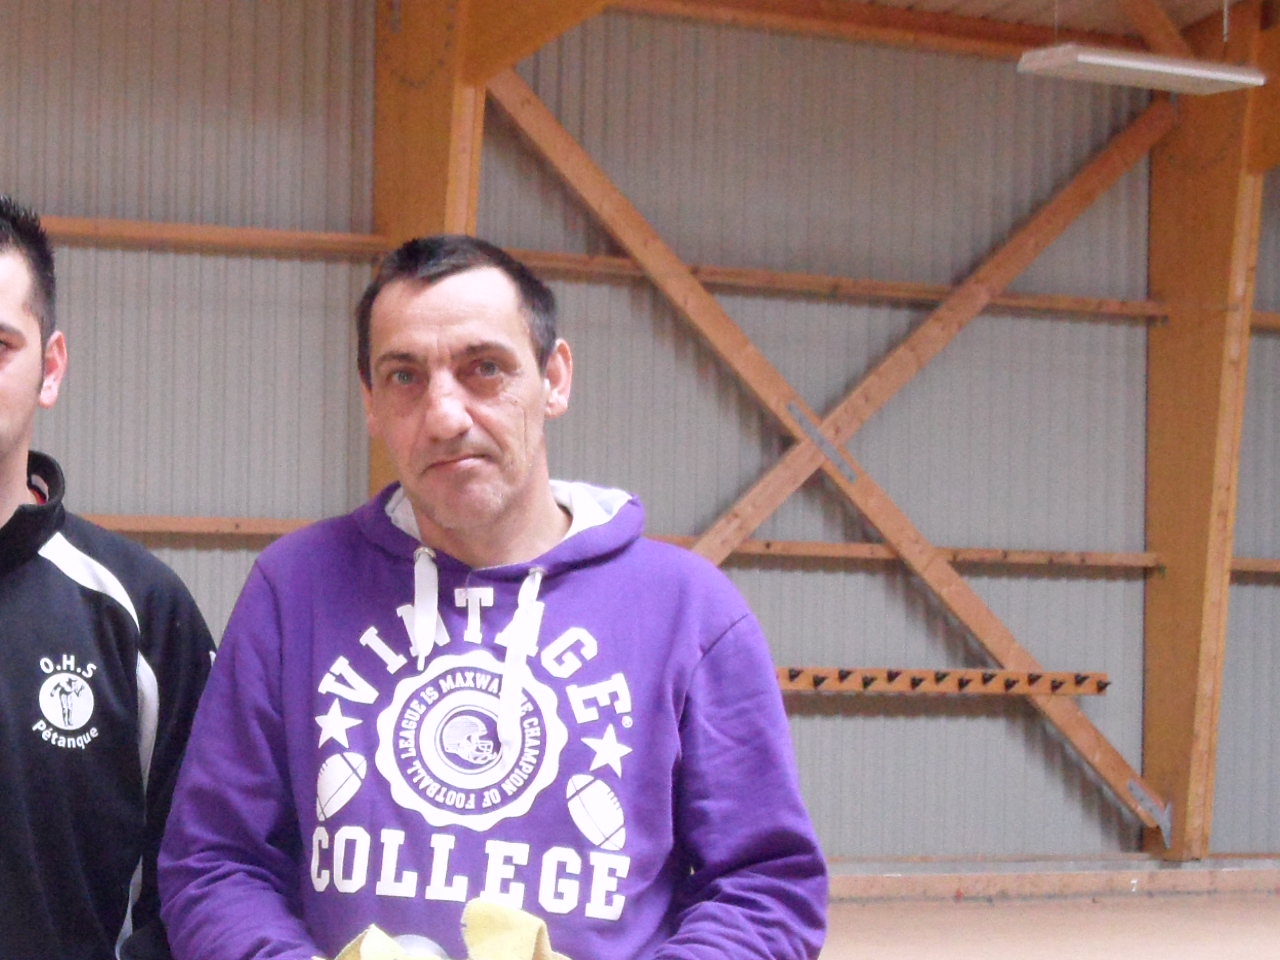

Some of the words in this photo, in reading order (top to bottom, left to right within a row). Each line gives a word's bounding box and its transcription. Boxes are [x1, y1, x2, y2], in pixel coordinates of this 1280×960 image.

[39, 654, 97, 678] O.H.S
[420, 686, 440, 706] IS
[32, 719, 99, 750] Pétanque
[398, 699, 427, 759] LEAGUE
[501, 717, 541, 796] CHAMPION
[406, 759, 476, 810] FOOTBALL
[482, 788, 502, 808] OF
[311, 825, 631, 920] COLLEGE
